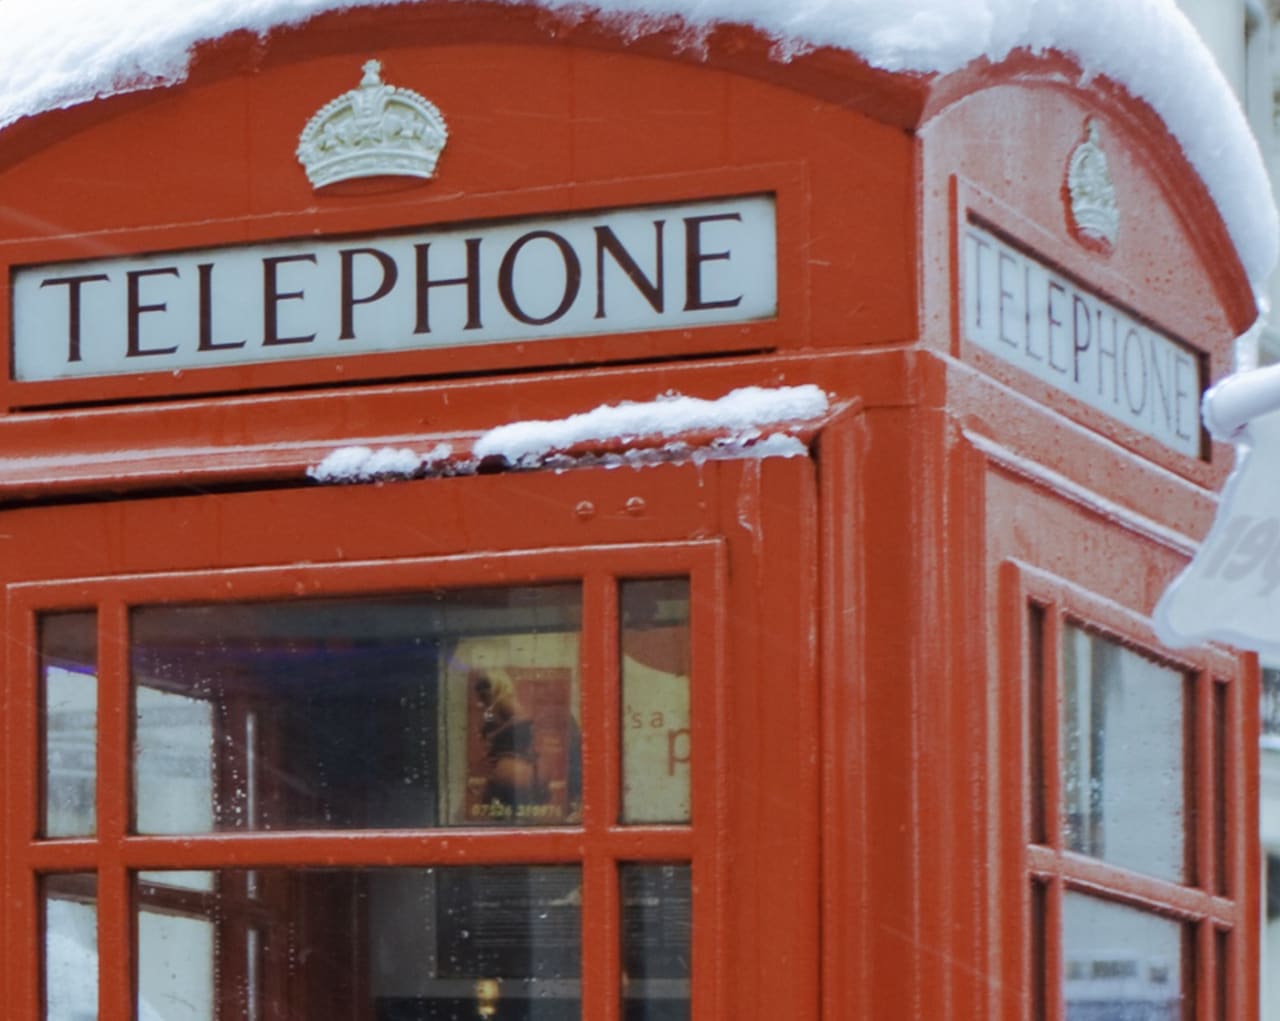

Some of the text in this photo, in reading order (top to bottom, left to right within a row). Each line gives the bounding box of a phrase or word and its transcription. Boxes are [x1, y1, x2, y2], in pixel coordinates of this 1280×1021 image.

[40, 212, 743, 362] TELEPHONE
[966, 231, 1191, 440] TELEPHONE
[650, 711, 664, 728] a
